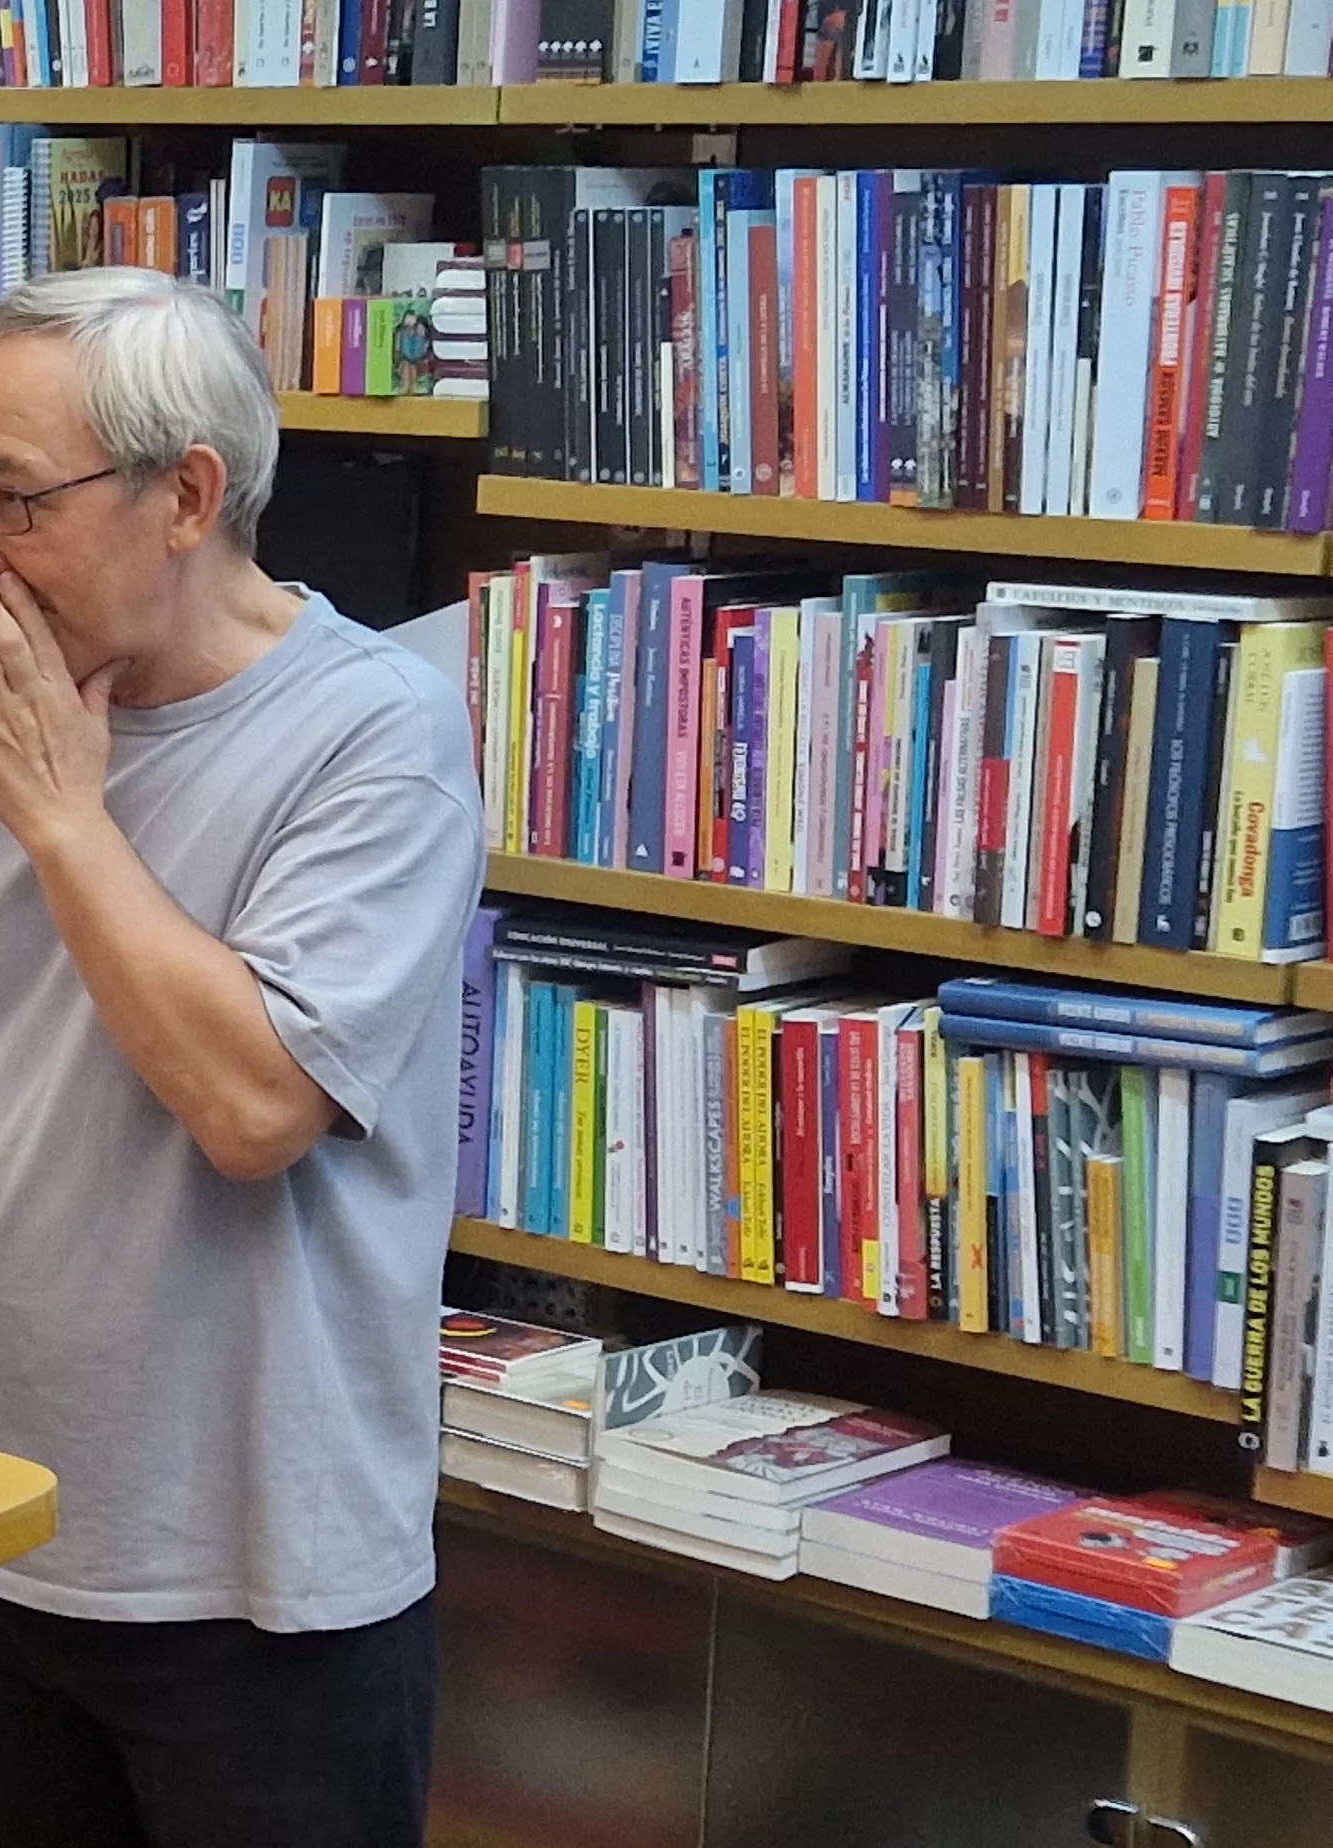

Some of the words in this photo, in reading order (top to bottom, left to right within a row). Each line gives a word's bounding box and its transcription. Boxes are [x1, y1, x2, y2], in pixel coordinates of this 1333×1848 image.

[59, 188, 91, 205] 2025
[1128, 189, 1148, 237] Pablo
[1124, 246, 1143, 307] Picasso
[590, 604, 605, 682] Lactancia
[609, 614, 623, 667] DISCIPLINA
[678, 597, 693, 664] AUTÉNTICAS
[586, 685, 601, 695] y
[676, 668, 691, 738] IMPOSTORAS
[584, 699, 601, 758] trabajo
[1171, 739, 1185, 760] LOS
[1237, 801, 1267, 898] Covadonga
[574, 1027, 590, 1084] DYER
[741, 1026, 752, 1041] EL
[757, 1028, 768, 1043] EL
[458, 980, 481, 1146] AUTOAYUDA
[740, 1044, 752, 1088] PODER
[756, 1046, 768, 1090] PODER
[740, 1091, 752, 1115] DEL
[756, 1092, 768, 1117] DEL
[707, 1100, 724, 1212] WALKSCAPES
[740, 1118, 752, 1165] AHORA
[756, 1120, 768, 1166] AHORA
[1253, 1165, 1276, 1244] MUNDOS
[929, 1198, 942, 1269] RESPUESTA
[929, 1271, 942, 1290] LA
[1250, 1249, 1271, 1285] LOS
[1248, 1290, 1268, 1313] DE
[1244, 1318, 1266, 1393] GUERRA
[1242, 1399, 1262, 1423] LA
